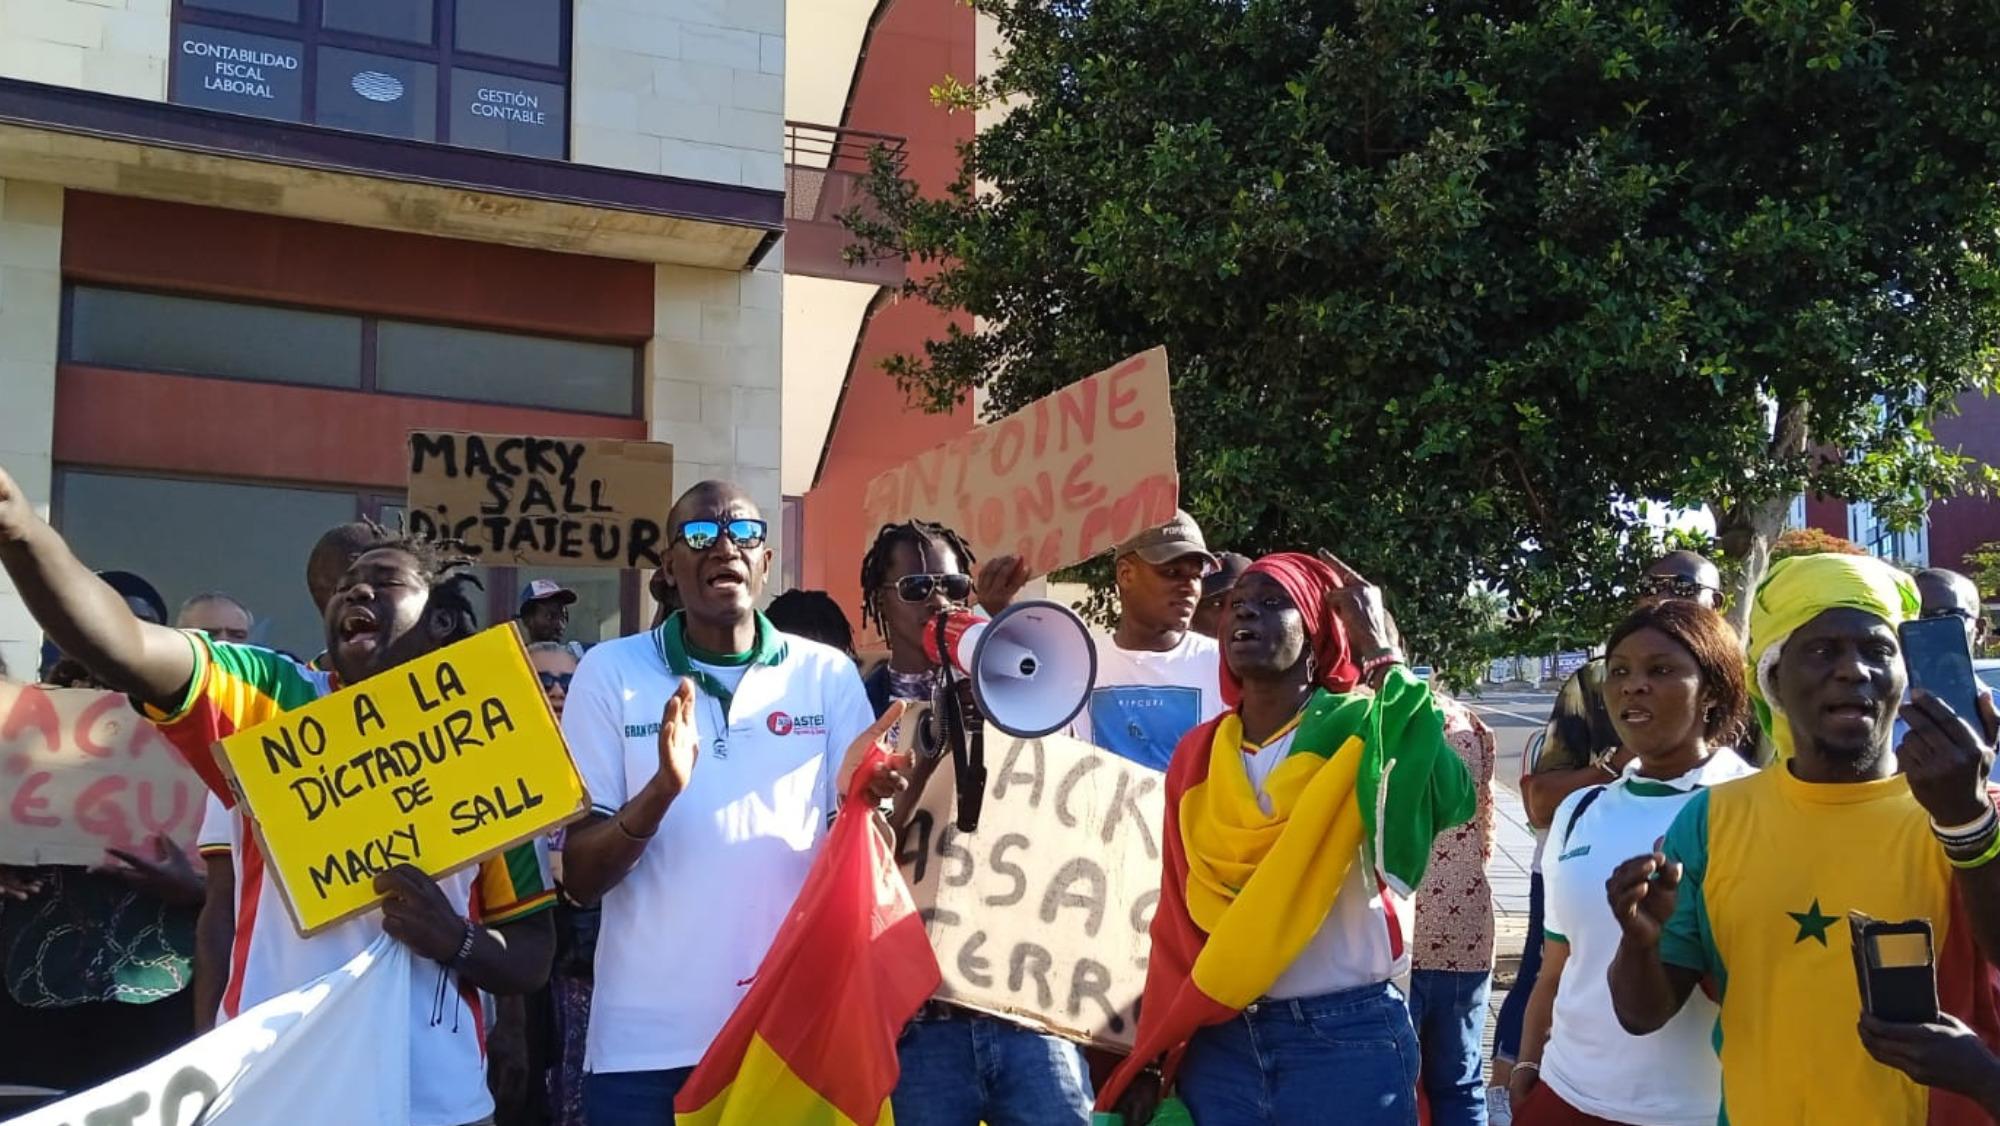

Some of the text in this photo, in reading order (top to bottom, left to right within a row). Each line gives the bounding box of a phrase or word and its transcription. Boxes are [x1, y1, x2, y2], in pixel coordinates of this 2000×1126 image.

[182, 40, 298, 70] CONTABILIDAD
[215, 62, 265, 81] FISCAL
[204, 76, 274, 99] LABORAL
[478, 88, 538, 108] GESTIÓN
[471, 102, 545, 126] CONTABLE
[411, 433, 585, 485] MACKY
[864, 357, 1147, 528] ANTOINE
[480, 472, 613, 514] SALL
[260, 661, 466, 774] NO A LA
[392, 778, 433, 814] DE
[309, 778, 546, 899] MACKY SALL
